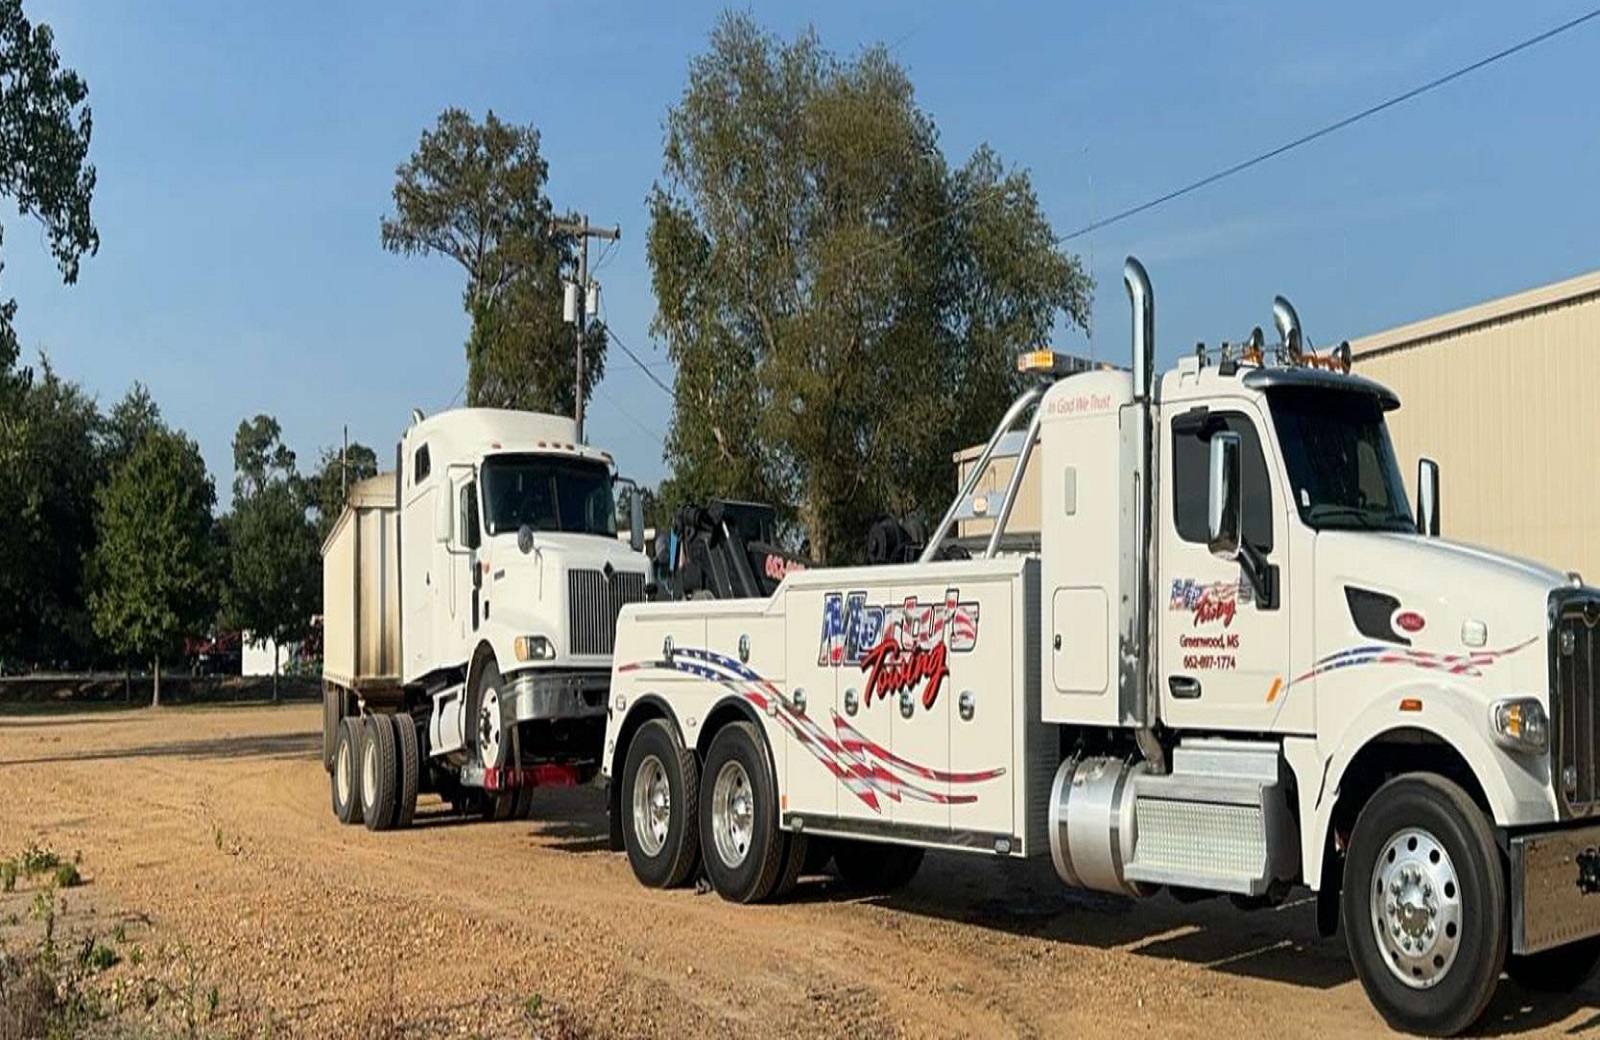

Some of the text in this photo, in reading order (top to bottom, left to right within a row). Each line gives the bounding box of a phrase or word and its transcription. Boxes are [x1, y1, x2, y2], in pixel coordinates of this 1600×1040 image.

[1057, 397, 1075, 414] God
[1075, 396, 1089, 412] We
[1090, 393, 1111, 410] Trust
[1191, 596, 1237, 628] Towing
[1179, 633, 1240, 649] Greenwood, MS
[860, 638, 950, 710] Towing
